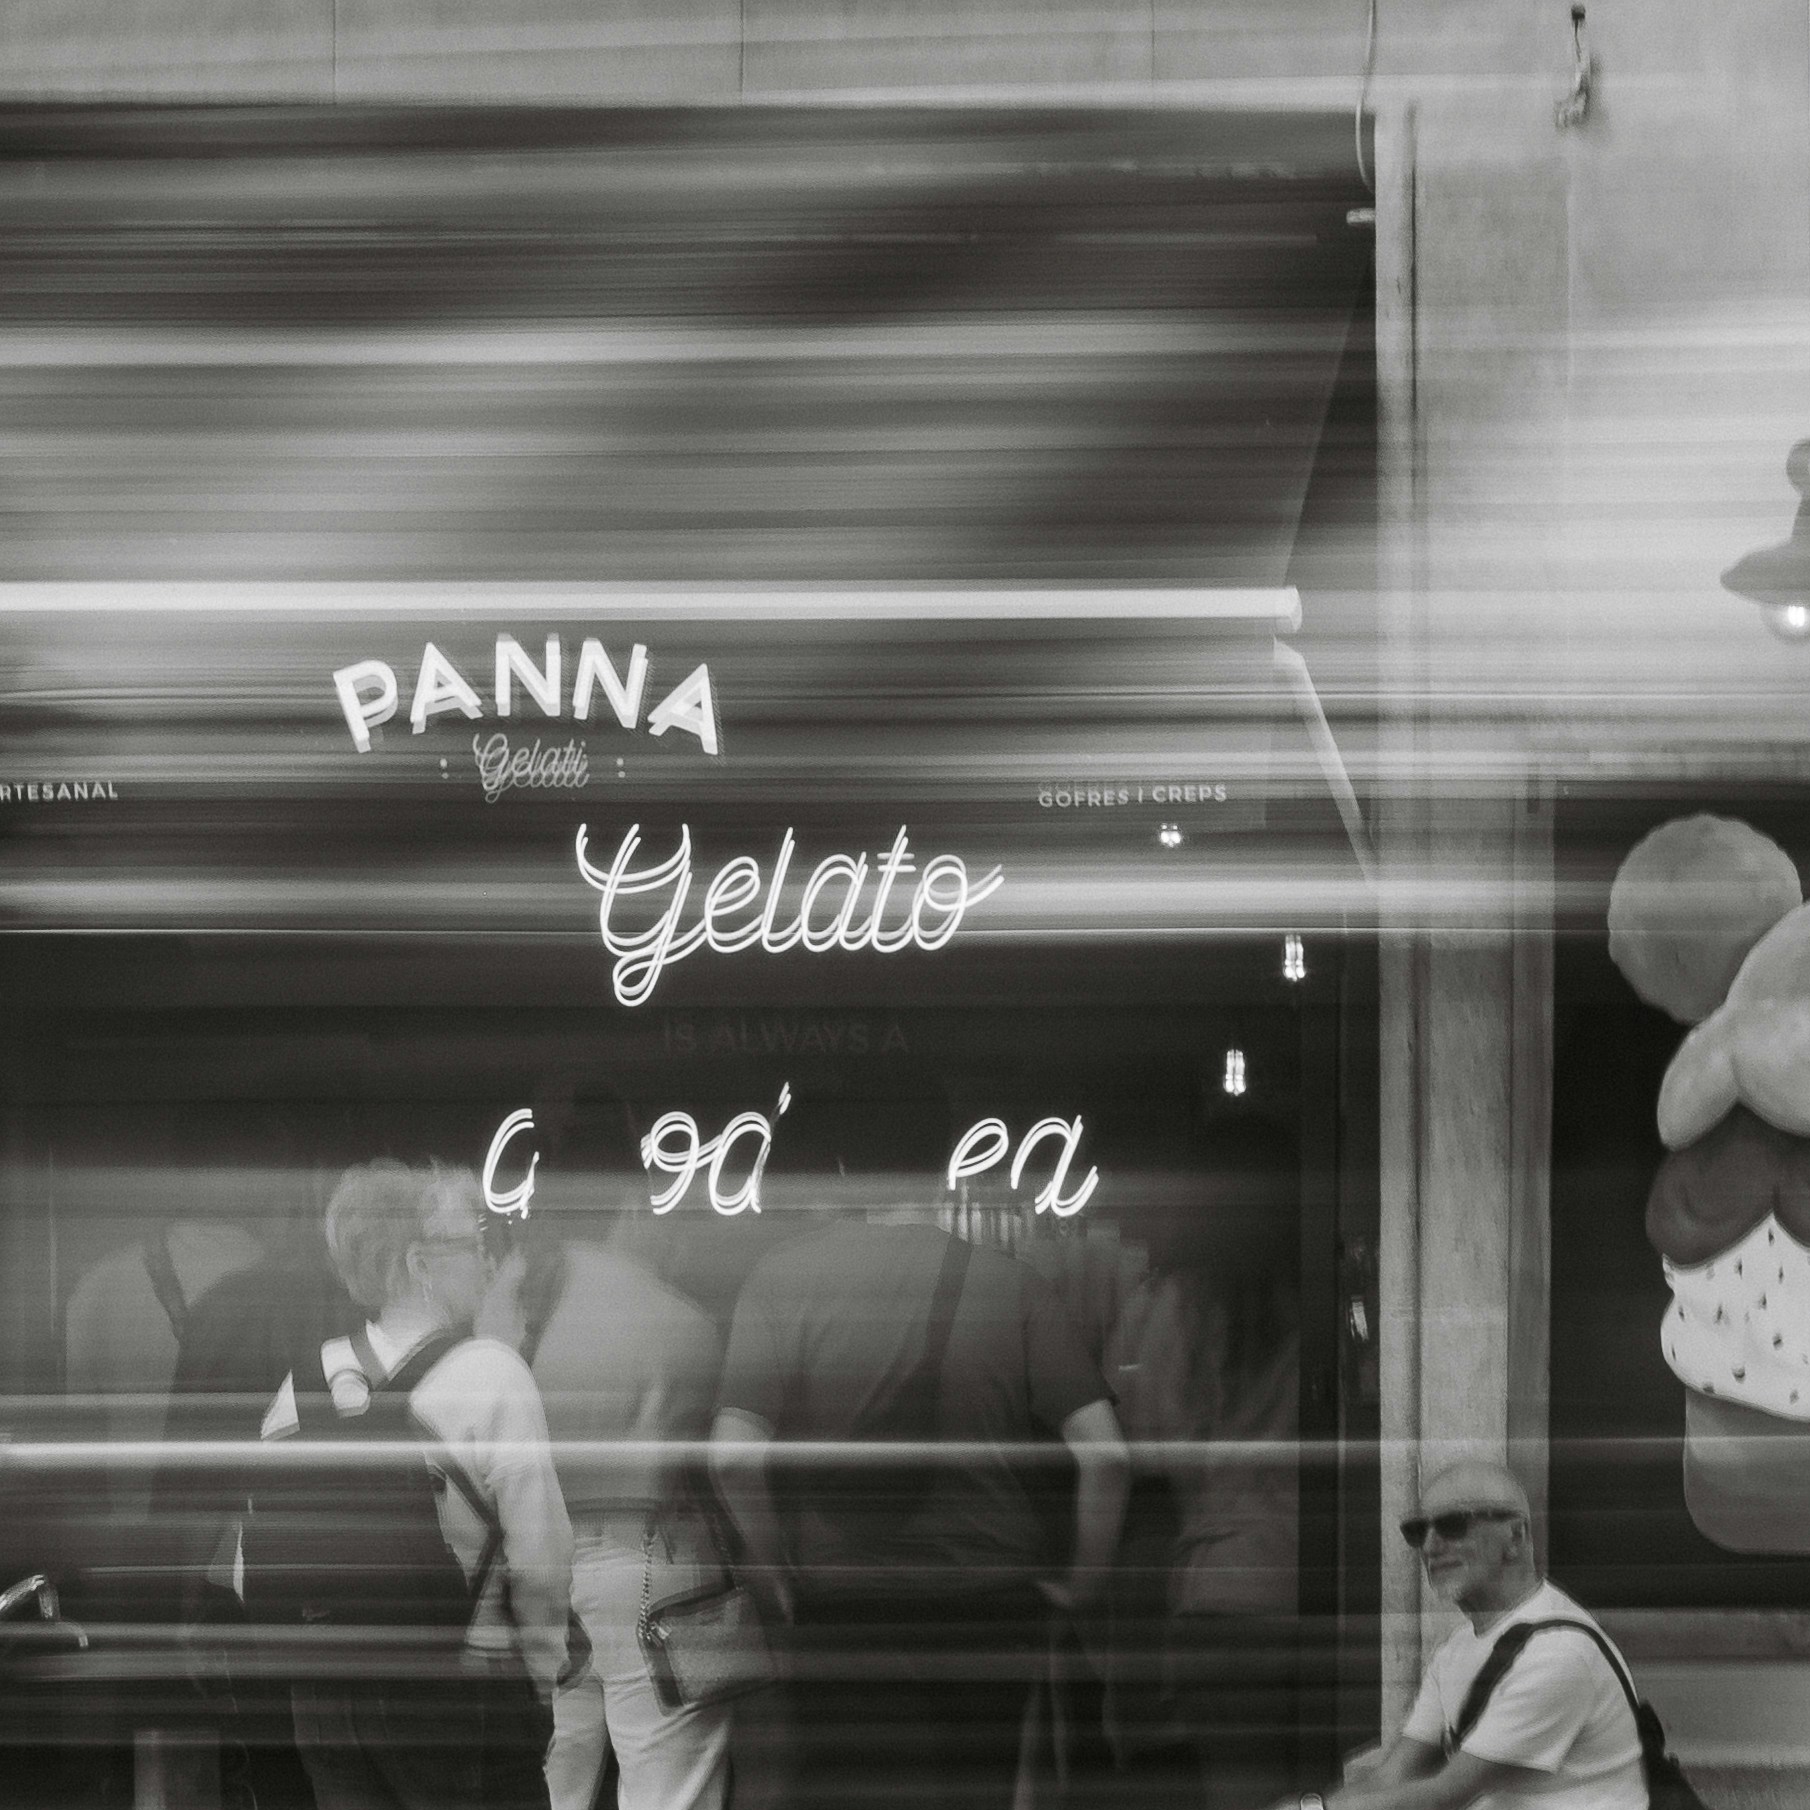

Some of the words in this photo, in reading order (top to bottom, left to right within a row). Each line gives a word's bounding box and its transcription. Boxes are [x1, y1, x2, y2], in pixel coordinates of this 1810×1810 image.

[333, 632, 722, 756] PANNA
[1037, 786, 1129, 809] GOFRES
[1152, 783, 1227, 804] CREPS
[576, 824, 1003, 1006] Gelato
